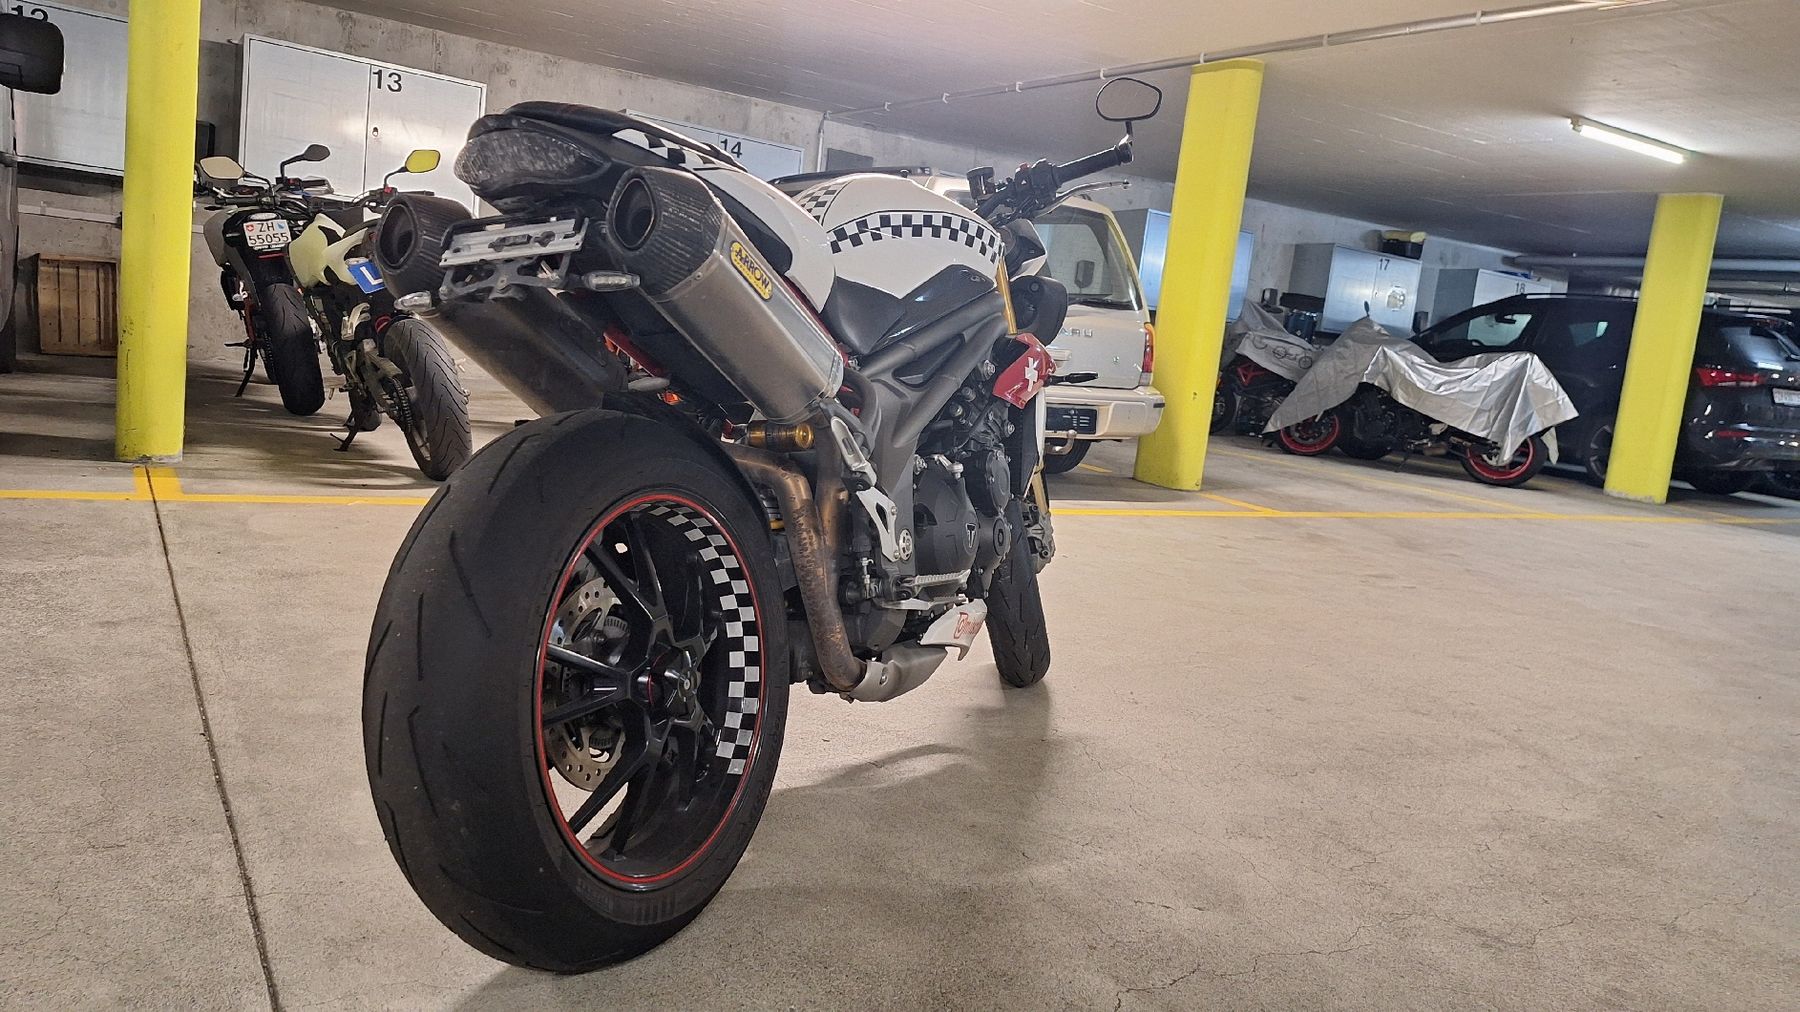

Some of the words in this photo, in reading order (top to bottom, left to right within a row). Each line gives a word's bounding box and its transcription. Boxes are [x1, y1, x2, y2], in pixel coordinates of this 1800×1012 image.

[373, 69, 402, 92] 13
[720, 138, 742, 158] 14
[258, 222, 274, 232] ZH
[249, 232, 289, 245] 55055
[735, 247, 770, 289] ARROW
[1379, 258, 1390, 270] 17
[360, 266, 383, 285] L
